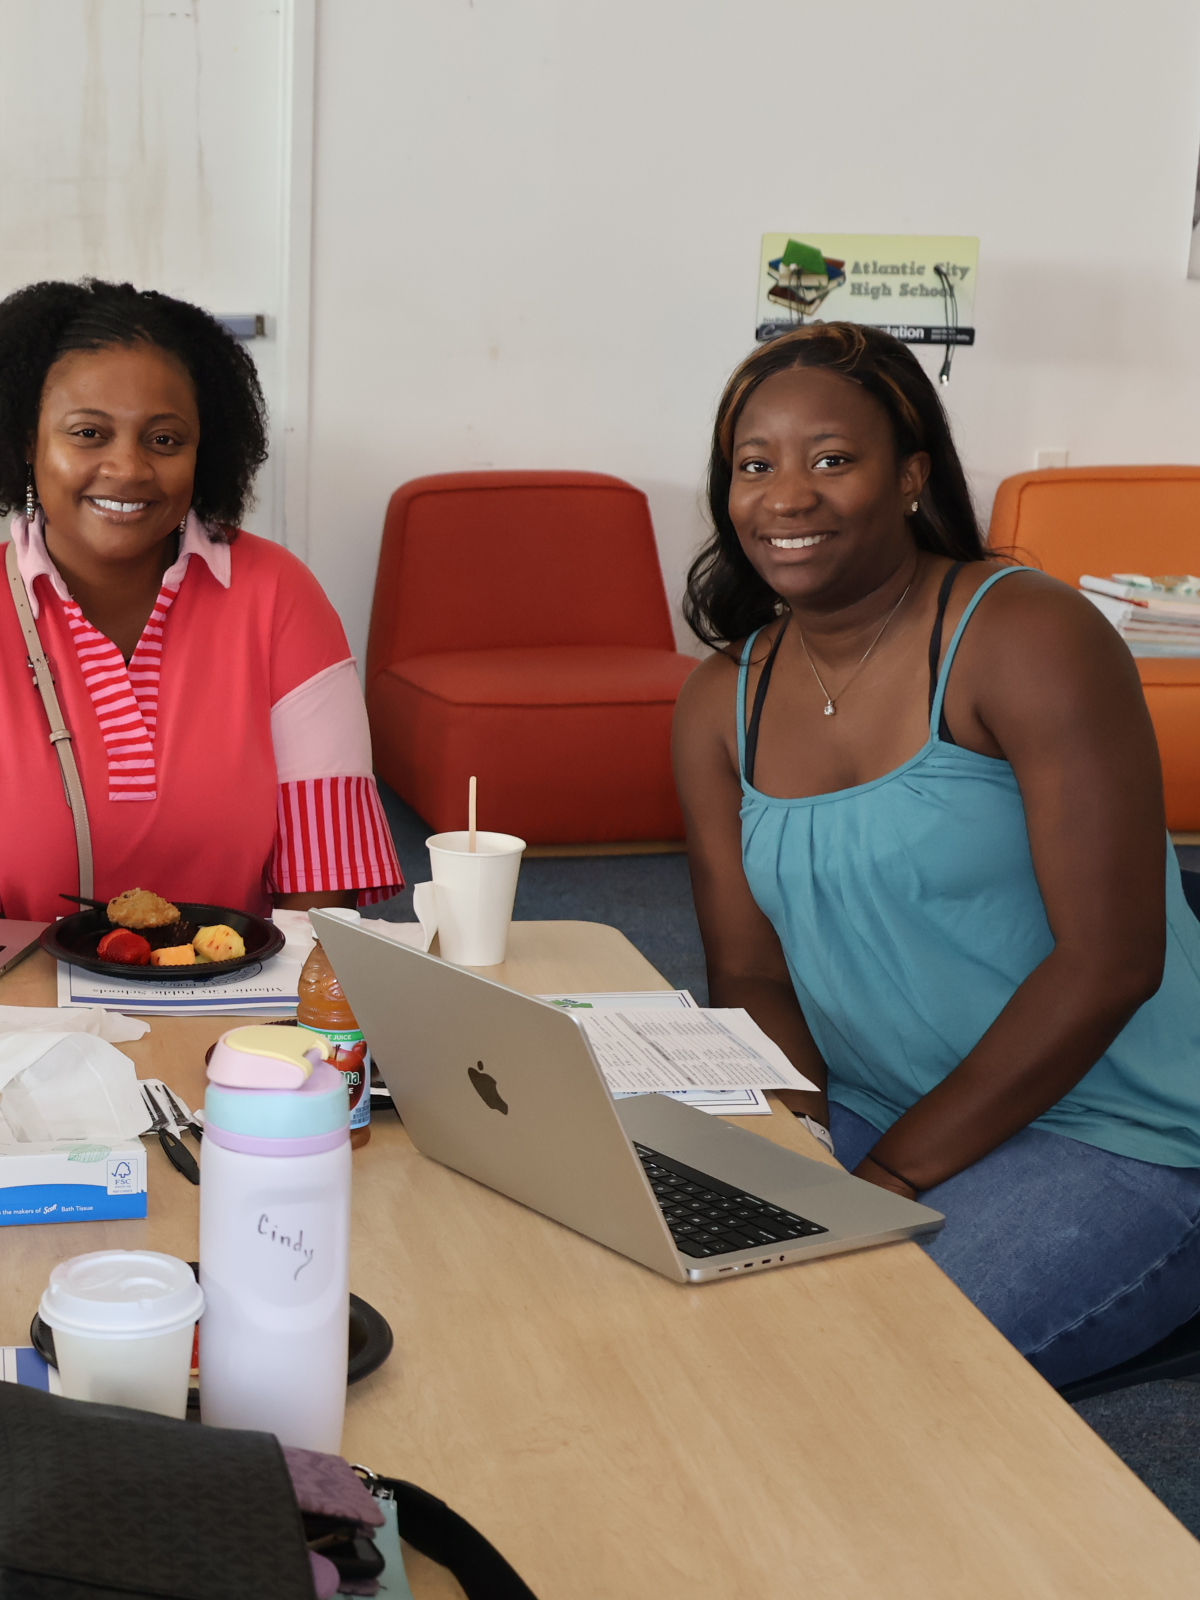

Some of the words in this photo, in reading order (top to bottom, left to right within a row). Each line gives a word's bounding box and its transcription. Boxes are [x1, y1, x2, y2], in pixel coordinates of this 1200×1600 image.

[851, 260, 926, 276] Atlantic
[850, 282, 892, 300] High
[899, 283, 954, 298] School
[258, 1213, 314, 1281] Cindy
